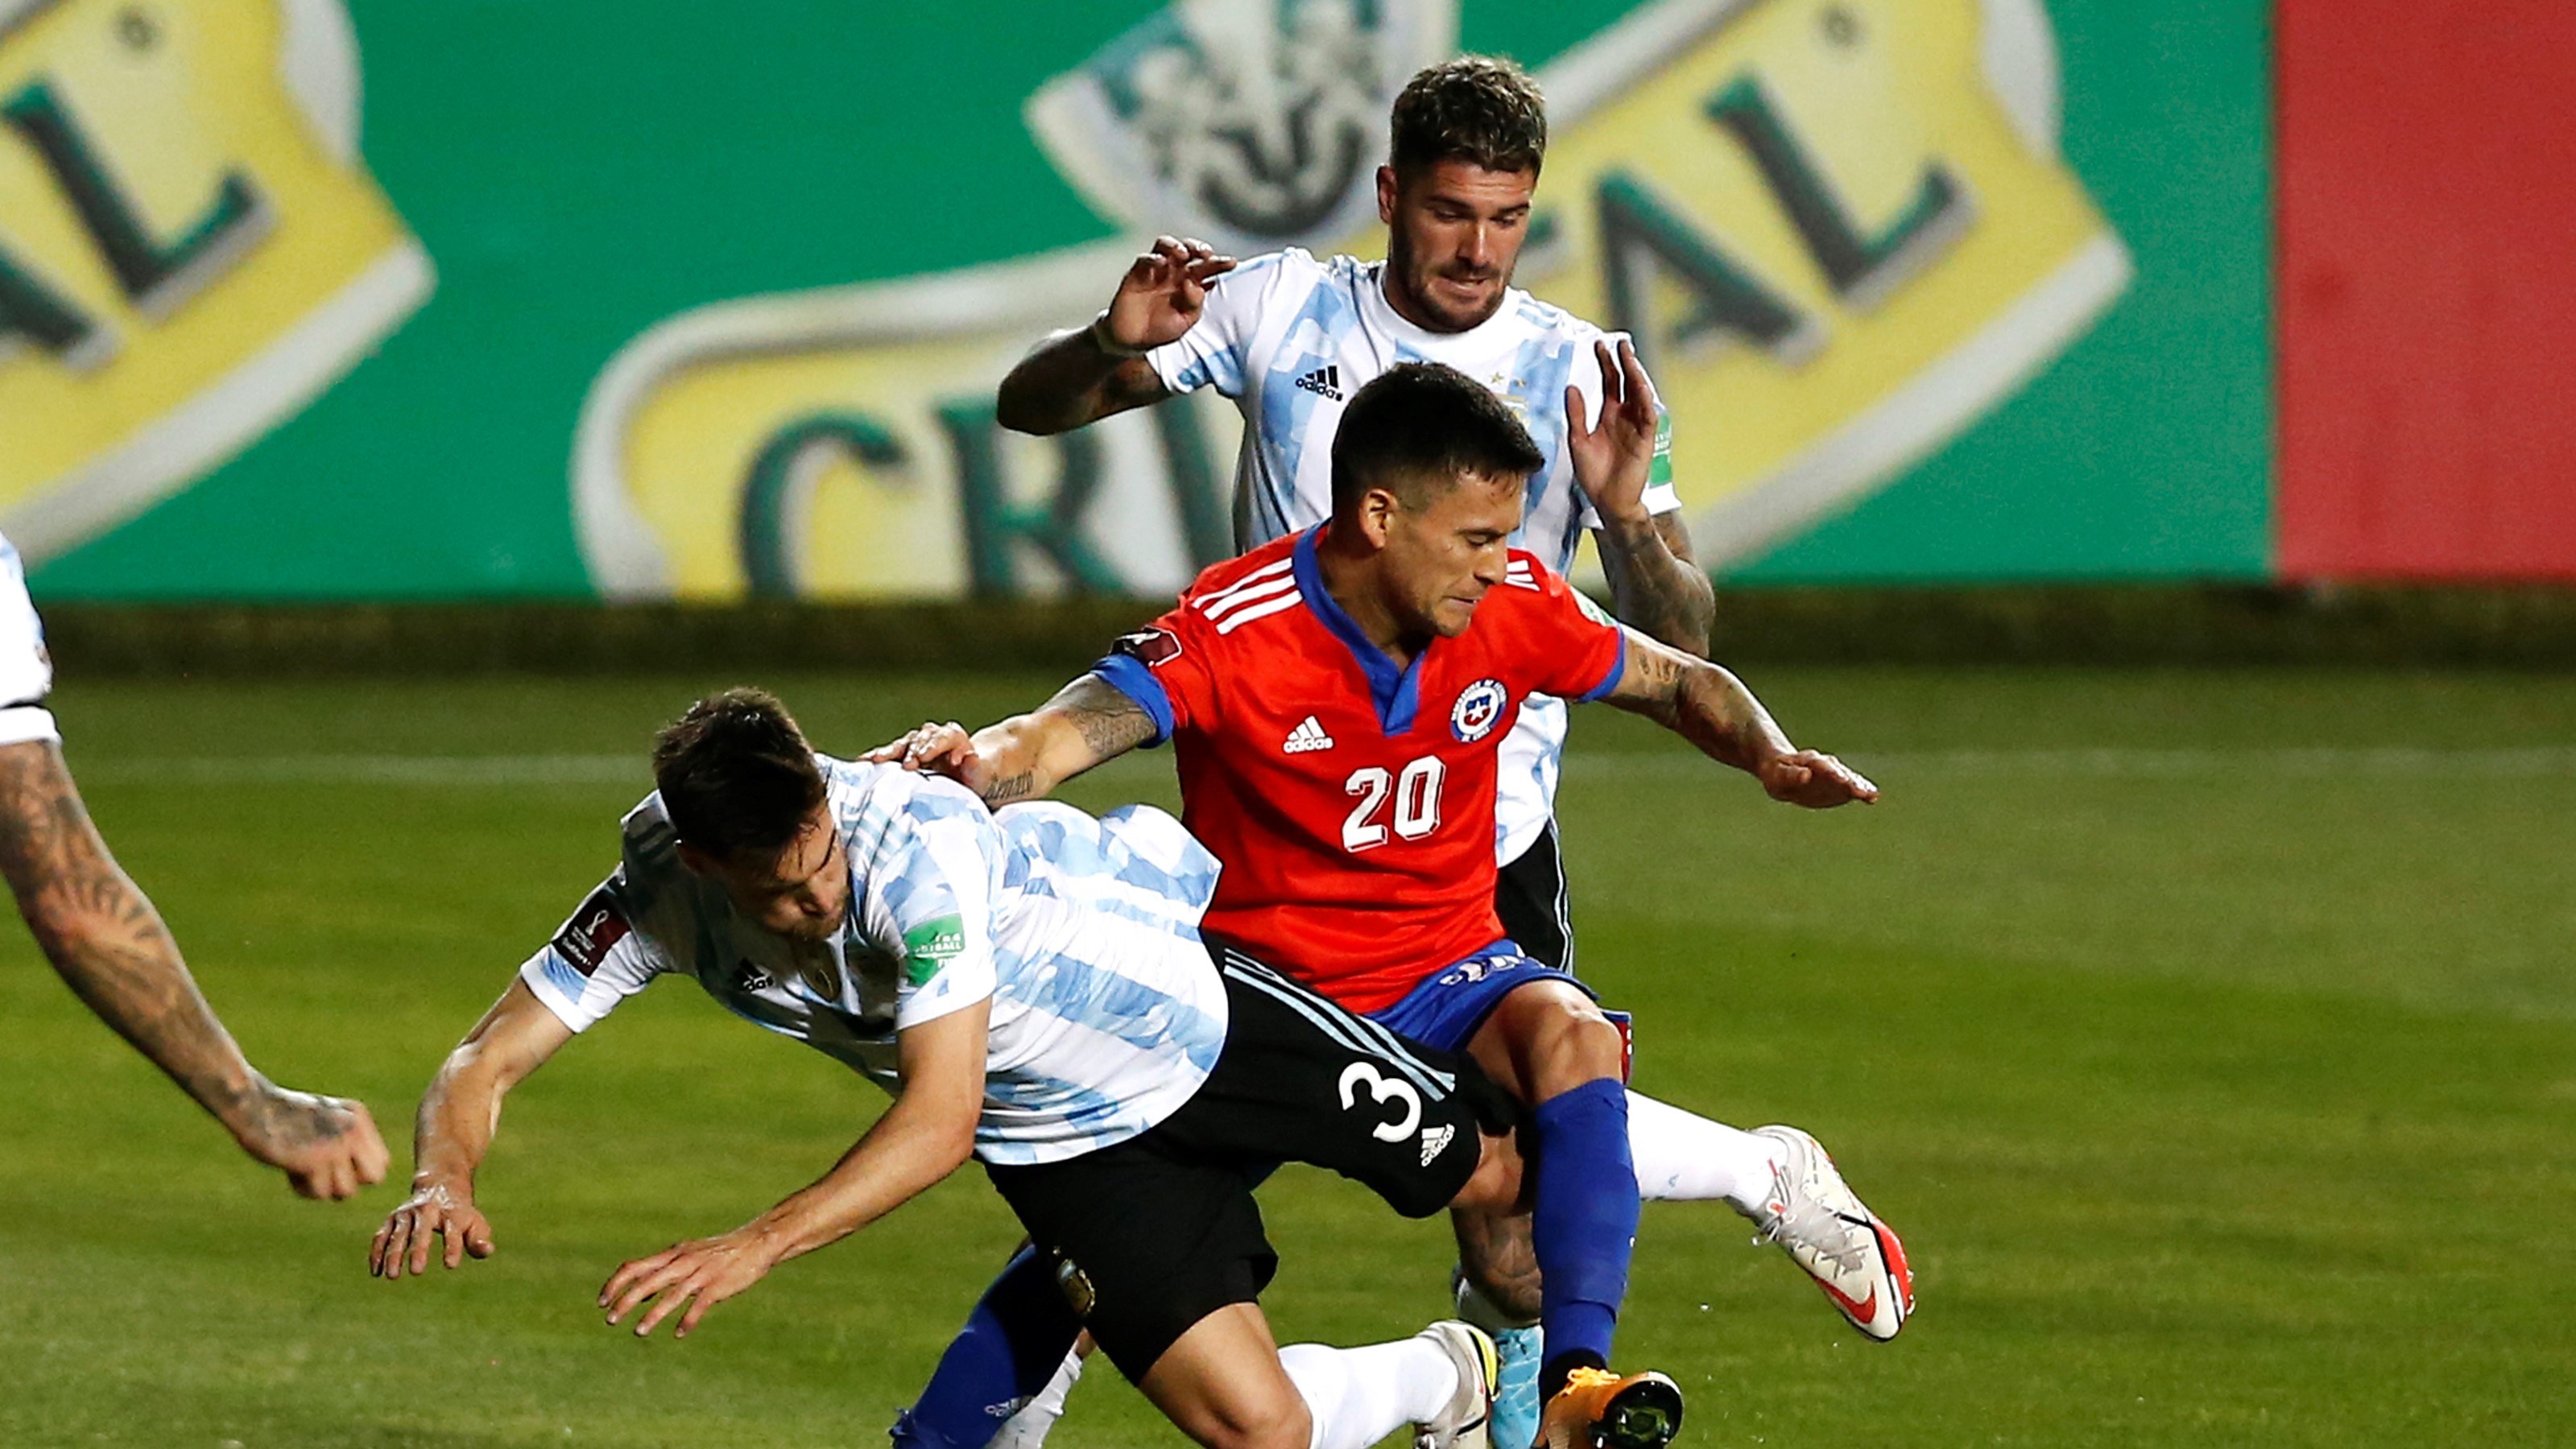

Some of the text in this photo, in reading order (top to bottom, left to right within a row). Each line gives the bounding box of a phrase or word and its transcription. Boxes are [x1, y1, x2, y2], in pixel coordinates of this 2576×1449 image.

[737, 74, 1969, 600] CRIAL
[1295, 377, 1343, 402] adidas
[1283, 737, 1334, 754] adidas
[1342, 754, 1446, 853] 20
[1338, 1061, 1422, 1143] 3
[1420, 1123, 1455, 1167] adidas
